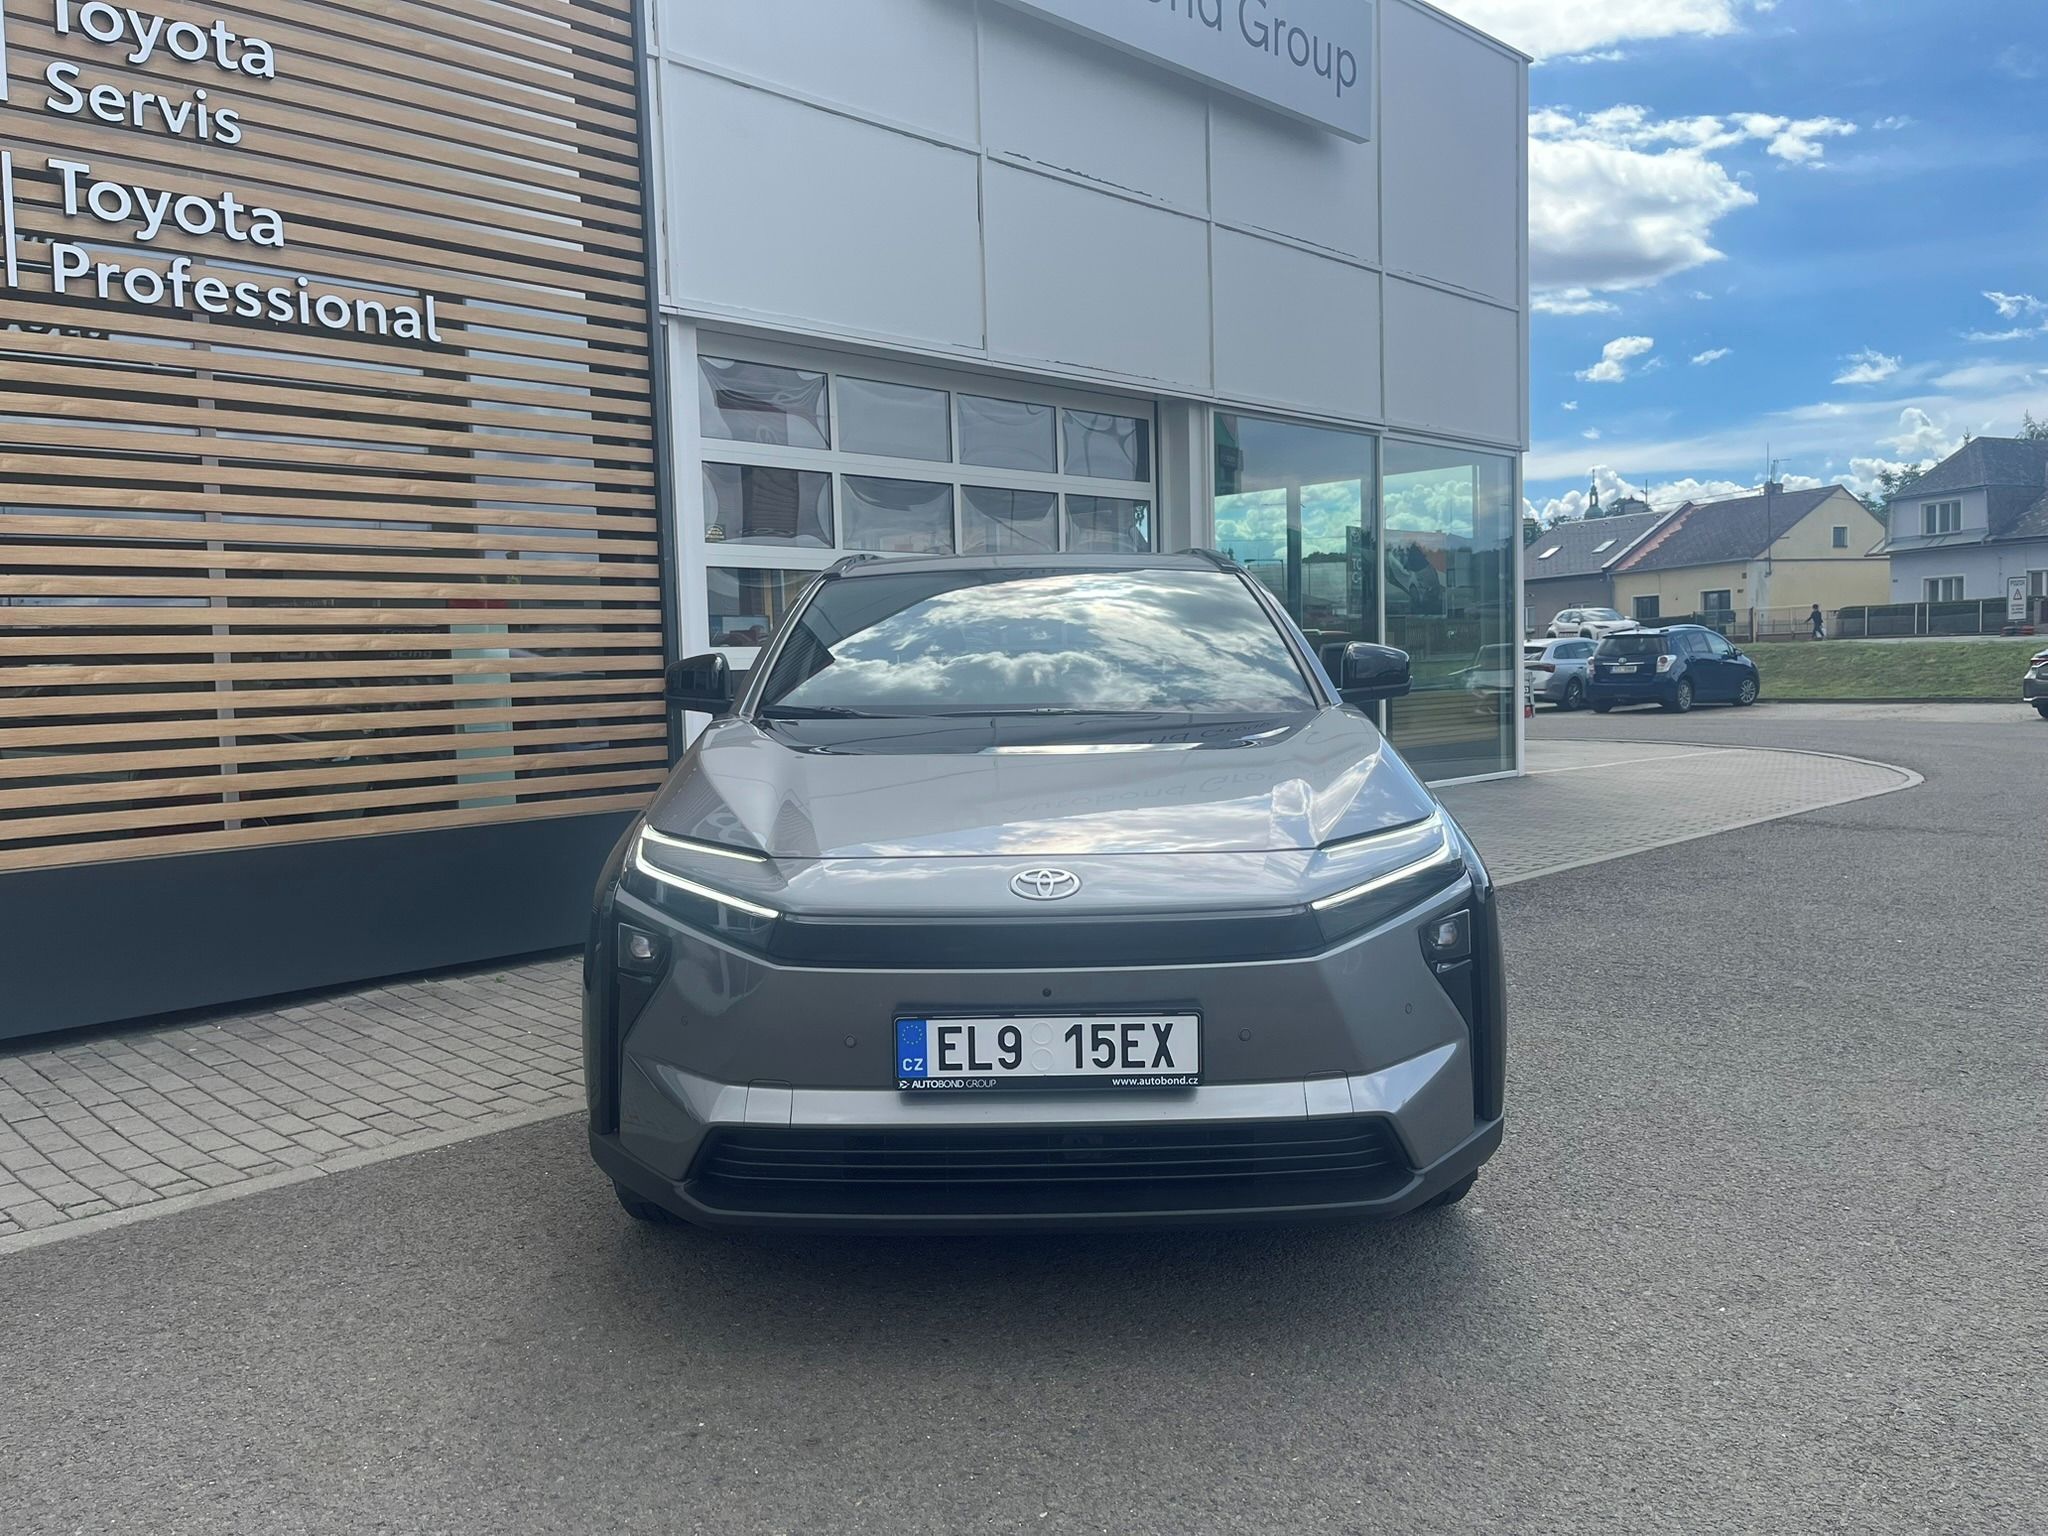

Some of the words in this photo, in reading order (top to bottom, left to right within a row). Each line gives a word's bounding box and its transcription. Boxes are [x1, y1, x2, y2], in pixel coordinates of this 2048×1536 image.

[48, 0, 275, 79] Toyota
[1239, 0, 1357, 98] Group
[45, 61, 242, 144] Servis
[47, 157, 285, 248] Toyota
[51, 241, 442, 343] Professional
[902, 1058, 924, 1071] CZ
[911, 1079, 965, 1089] AUTOBOND
[965, 1079, 997, 1088] GROUP
[937, 1024, 1022, 1071] EL9
[1064, 1023, 1176, 1069] 15EX
[1112, 1076, 1199, 1086] www.autobond.cz
